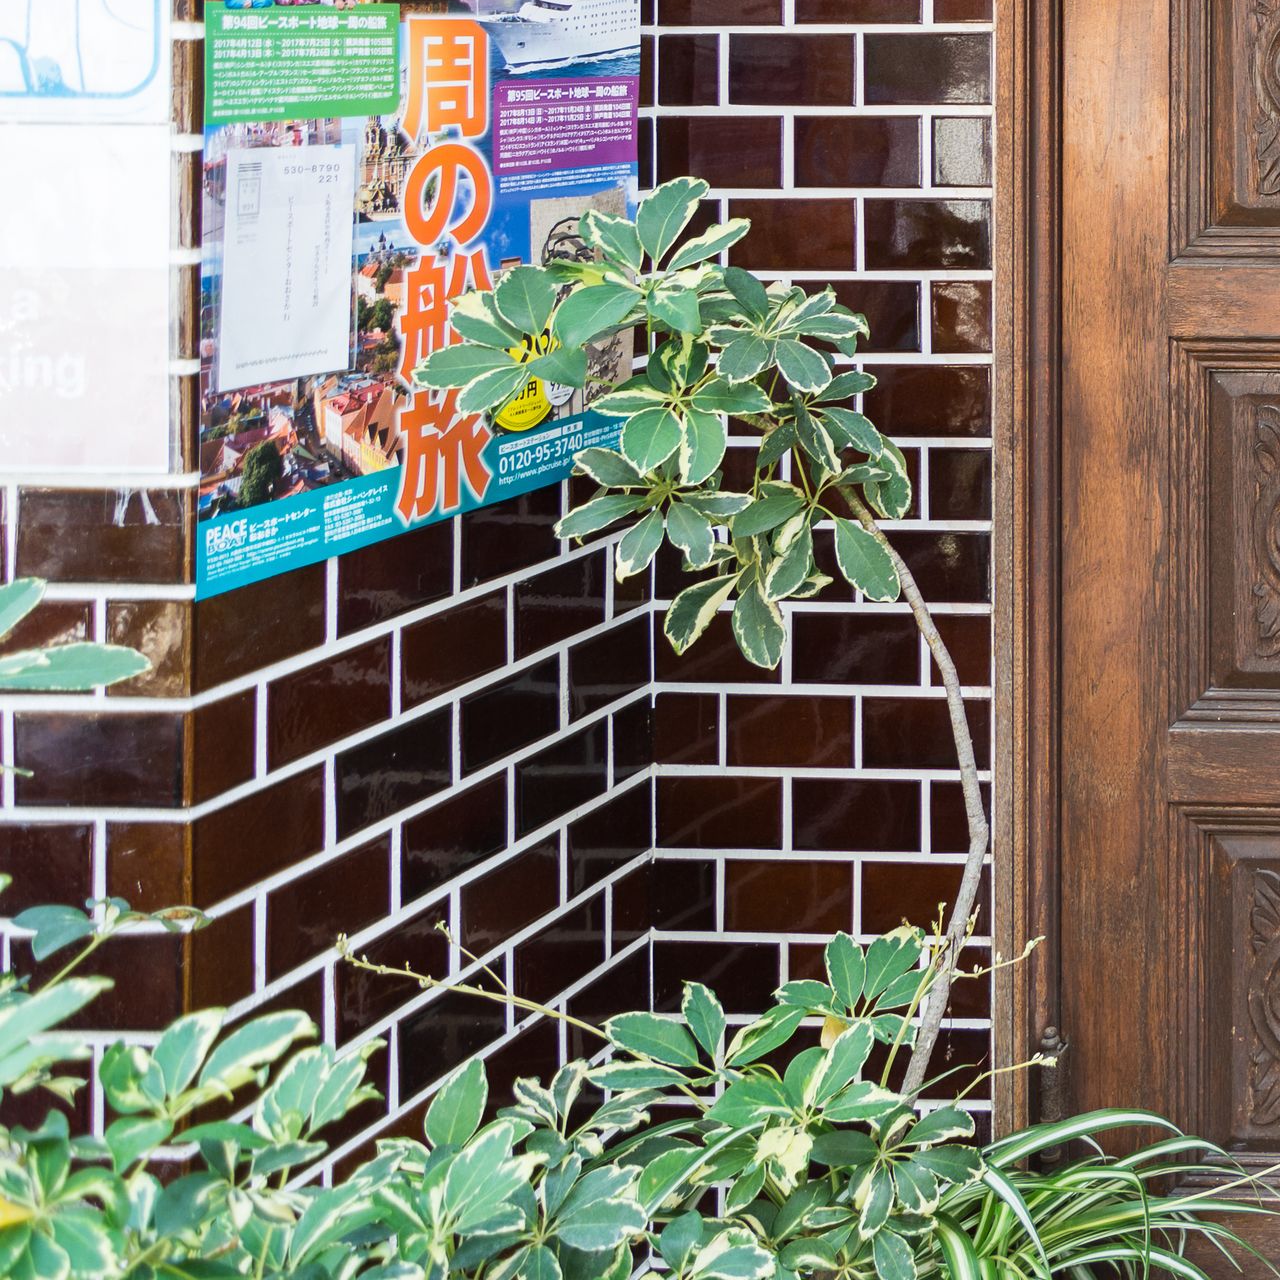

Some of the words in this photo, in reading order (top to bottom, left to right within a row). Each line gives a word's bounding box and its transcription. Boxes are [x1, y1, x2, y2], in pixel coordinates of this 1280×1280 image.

[284, 163, 340, 175] 530-8790
[319, 174, 339, 184] 221
[499, 433, 583, 475] 0120-95-3740
[206, 518, 248, 545] PEACE
